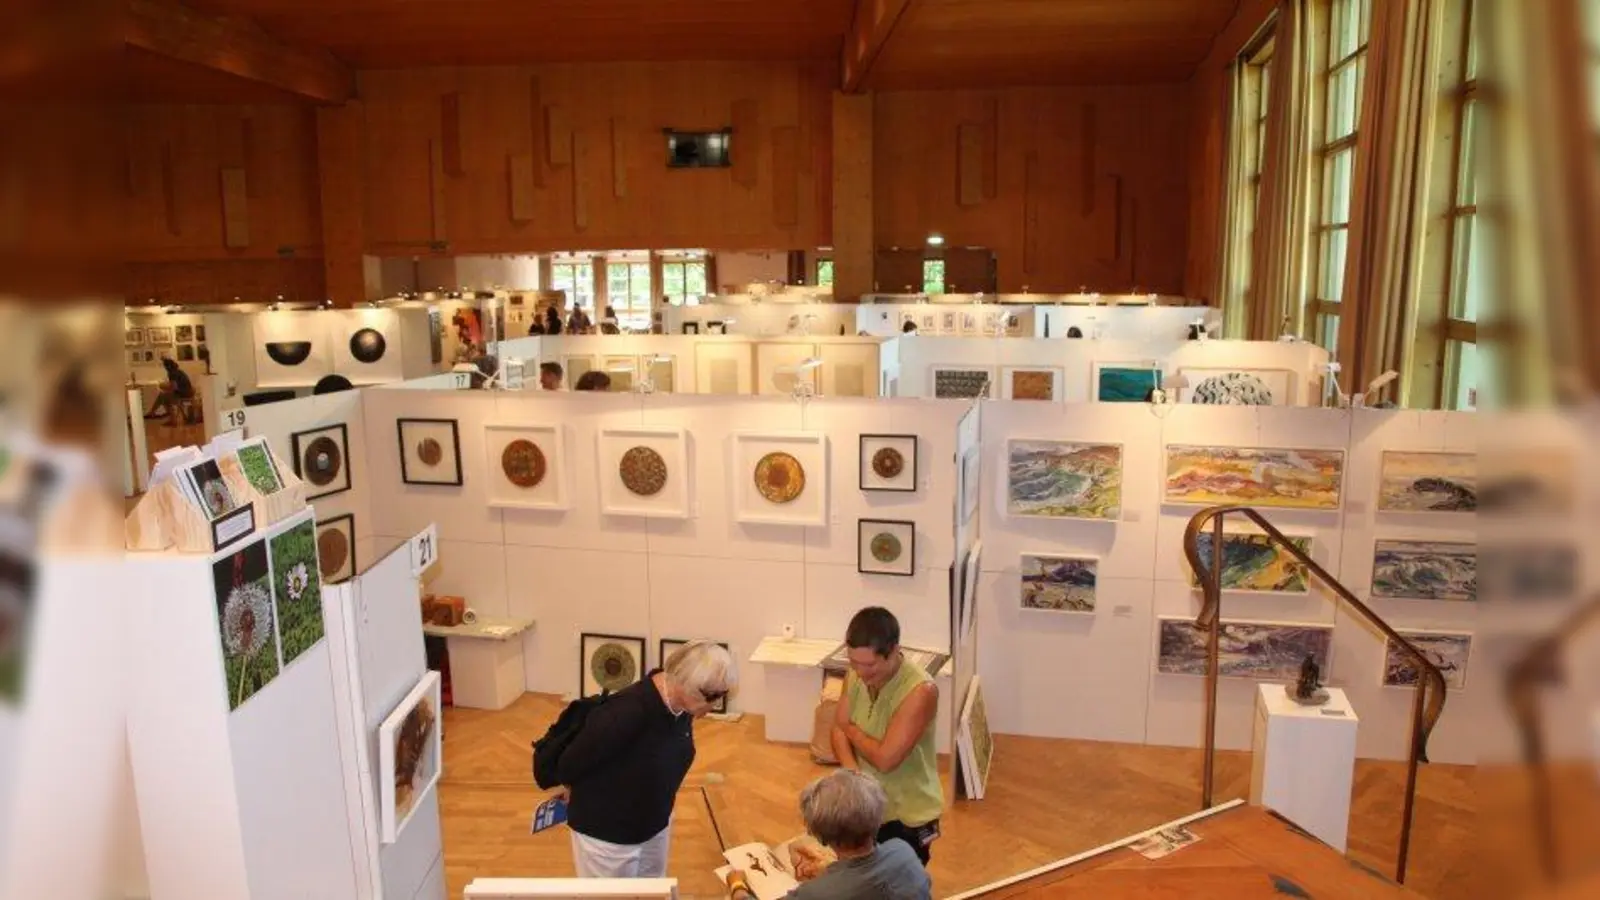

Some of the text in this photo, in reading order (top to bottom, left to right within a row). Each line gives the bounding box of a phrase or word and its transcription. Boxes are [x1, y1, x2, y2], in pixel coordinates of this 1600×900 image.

[455, 374, 466, 388] 17
[227, 410, 246, 426] 19
[419, 534, 431, 567] 21
